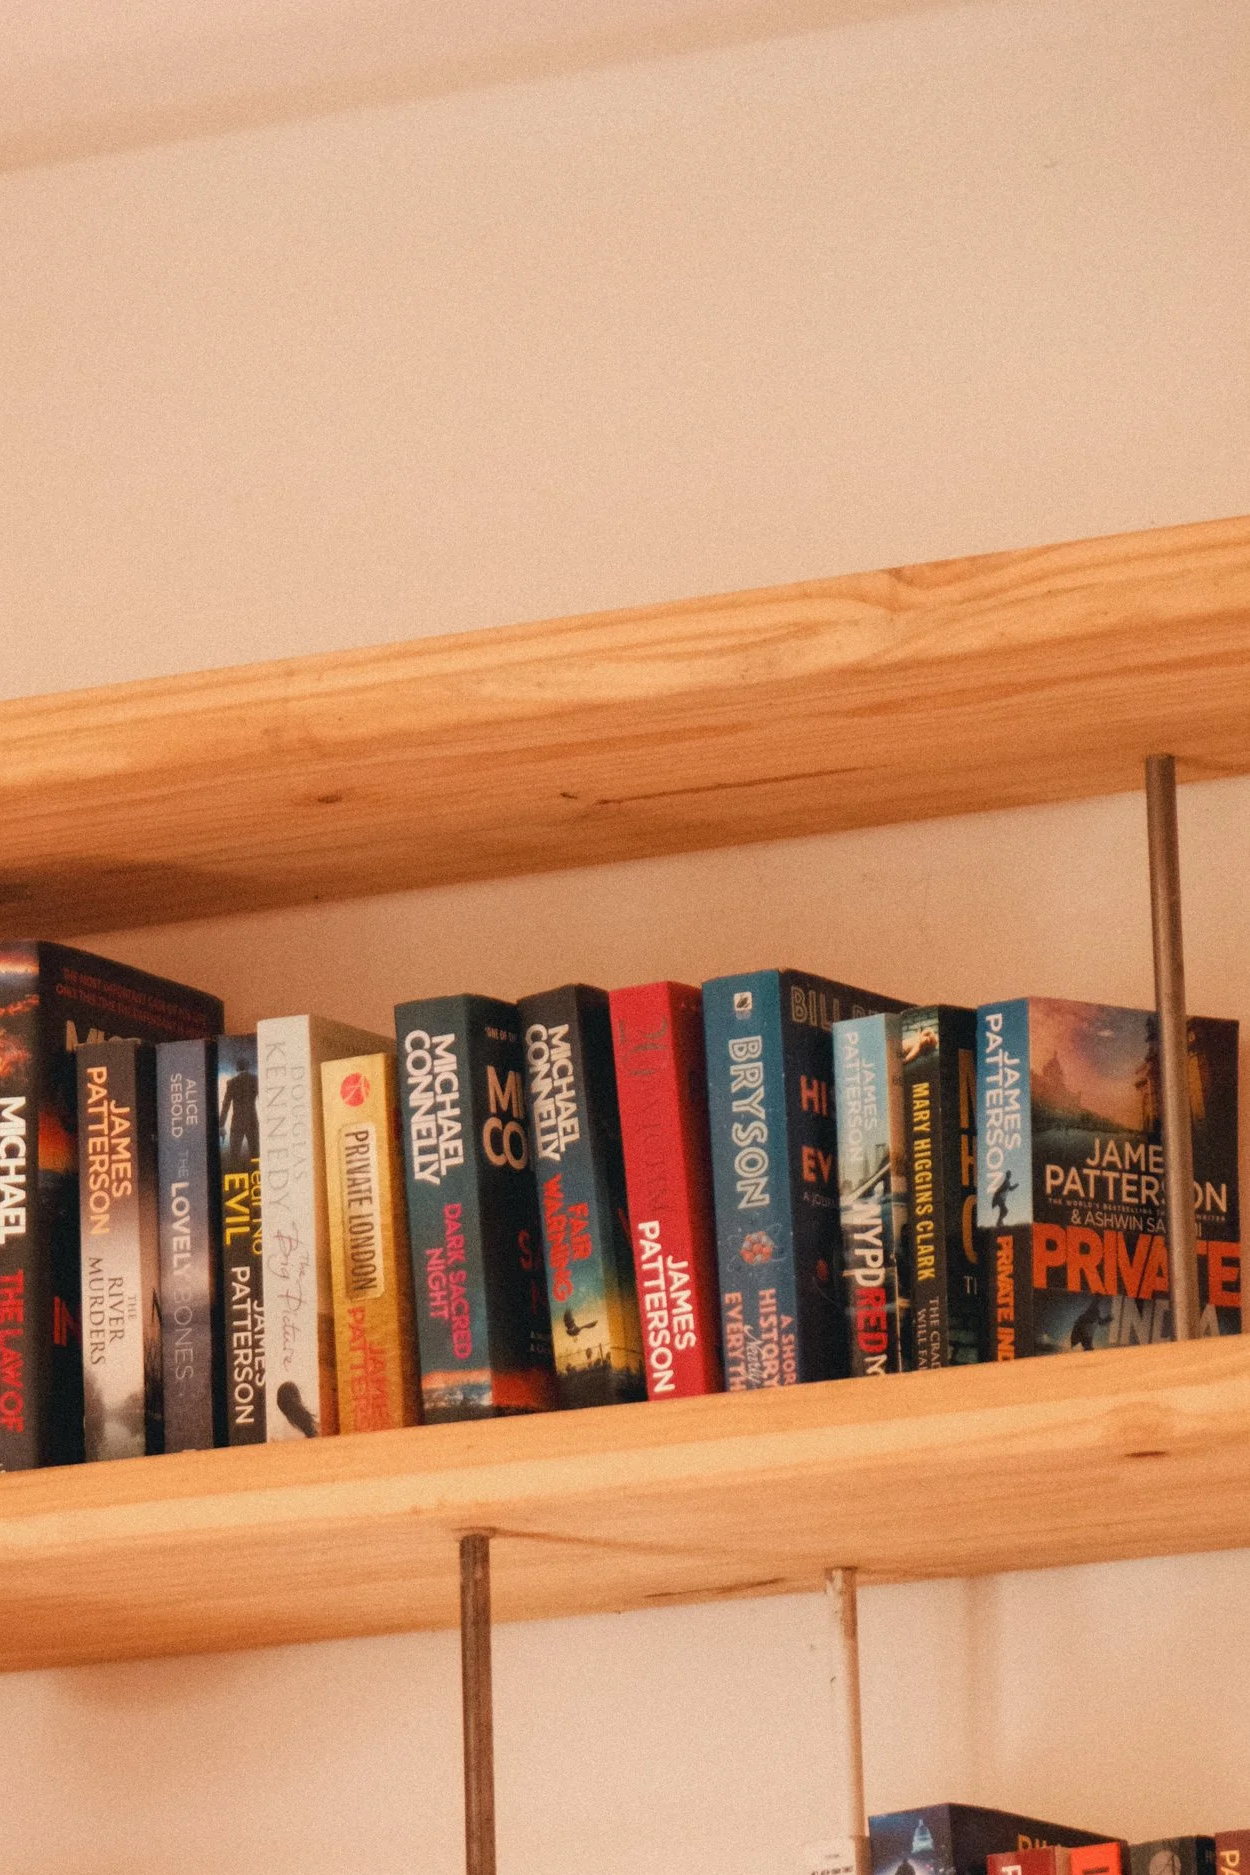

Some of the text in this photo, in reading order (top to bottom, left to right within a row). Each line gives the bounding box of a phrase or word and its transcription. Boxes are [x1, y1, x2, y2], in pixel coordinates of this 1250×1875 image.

[170, 1073, 183, 1139] SEBOLD
[185, 1078, 198, 1126] ALICE
[265, 1042, 291, 1216] KENNEDY
[290, 1065, 308, 1181] DOUGLAS
[405, 1029, 440, 1186] CONNELLY
[431, 1032, 464, 1177] MICHAEL
[525, 1024, 561, 1161] CONNELLY
[548, 1024, 579, 1152] MICHAEL
[728, 1035, 769, 1210] BRYSON
[843, 1032, 864, 1163] PATTERSON
[862, 1059, 877, 1131] JAMES
[985, 1014, 1003, 1195] PATTERSON
[1003, 1051, 1020, 1150] JAMES
[86, 1067, 111, 1235] PATTERSON
[111, 1097, 132, 1198] JAMES
[912, 1082, 936, 1281] MARY HIGGINS CLARK
[1045, 1164, 1227, 1213] PATTERN
[224, 1171, 243, 1246] EVIL
[345, 1128, 377, 1292] PRIVATE LONDON
[542, 1174, 572, 1302] WARNING
[569, 1202, 592, 1261] FAIR
[1071, 1210, 1081, 1224] &
[1085, 1212, 1143, 1232] ASHWIN
[88, 1257, 107, 1366] MURDERS
[109, 1276, 124, 1344] RIVER
[128, 1296, 137, 1321] THE
[170, 1148, 194, 1382] THE LOVELY BONES
[425, 1248, 450, 1320] NIGHT
[444, 1203, 471, 1359] DARK SACRED
[638, 1221, 676, 1392] PATTERSON
[666, 1256, 696, 1349] JAMES
[929, 1297, 939, 1327] THE
[997, 1236, 1014, 1321] PRIVATE
[0, 1270, 25, 1432] THE LAW OF
[231, 1265, 255, 1425] PATTERSON
[278, 1290, 301, 1372] Picture
[758, 1288, 781, 1388] HISTORY
[780, 1314, 794, 1328] A
[916, 1308, 927, 1344] WILL
